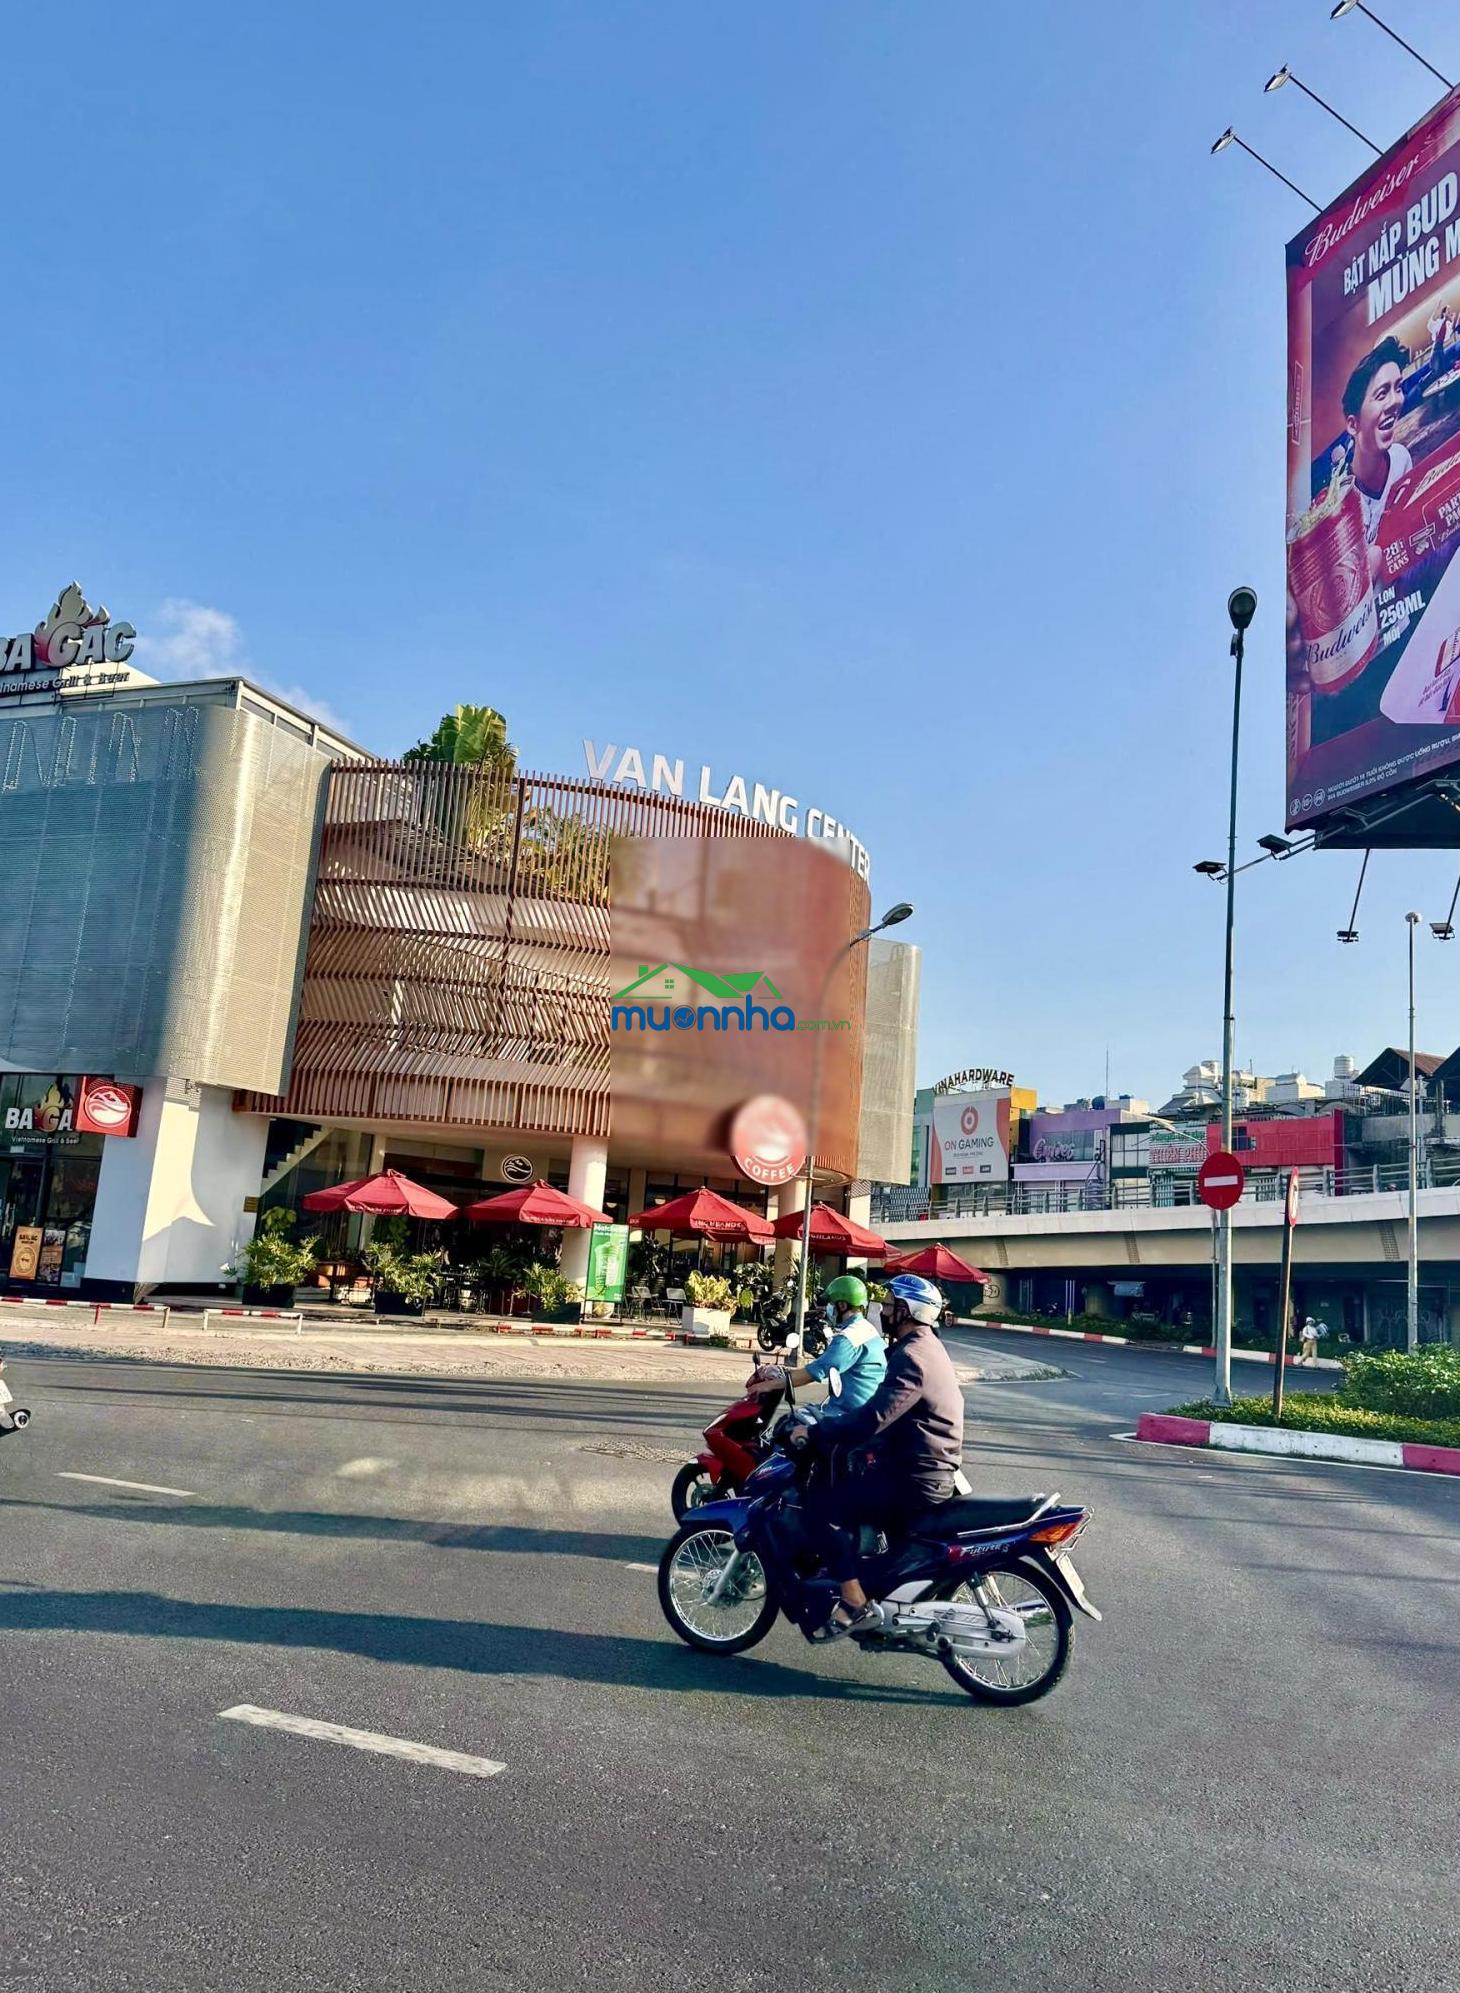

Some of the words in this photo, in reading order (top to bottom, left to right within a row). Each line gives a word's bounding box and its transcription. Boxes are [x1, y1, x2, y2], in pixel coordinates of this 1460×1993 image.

[1305, 154, 1419, 267] Budweiser
[1407, 172, 1458, 247] BUD
[1388, 554, 1409, 575] CANS
[1378, 586, 1396, 606] LON
[1379, 590, 1426, 629] 250ML
[583, 739, 684, 797] VAN
[699, 766, 799, 834] LANG
[933, 1068, 1015, 1094] VINAHARDWARE
[5, 1107, 33, 1129] BA
[945, 1141, 956, 1150] ON
[959, 1137, 994, 1150] GAMING
[743, 1157, 795, 1180] COFFEE
